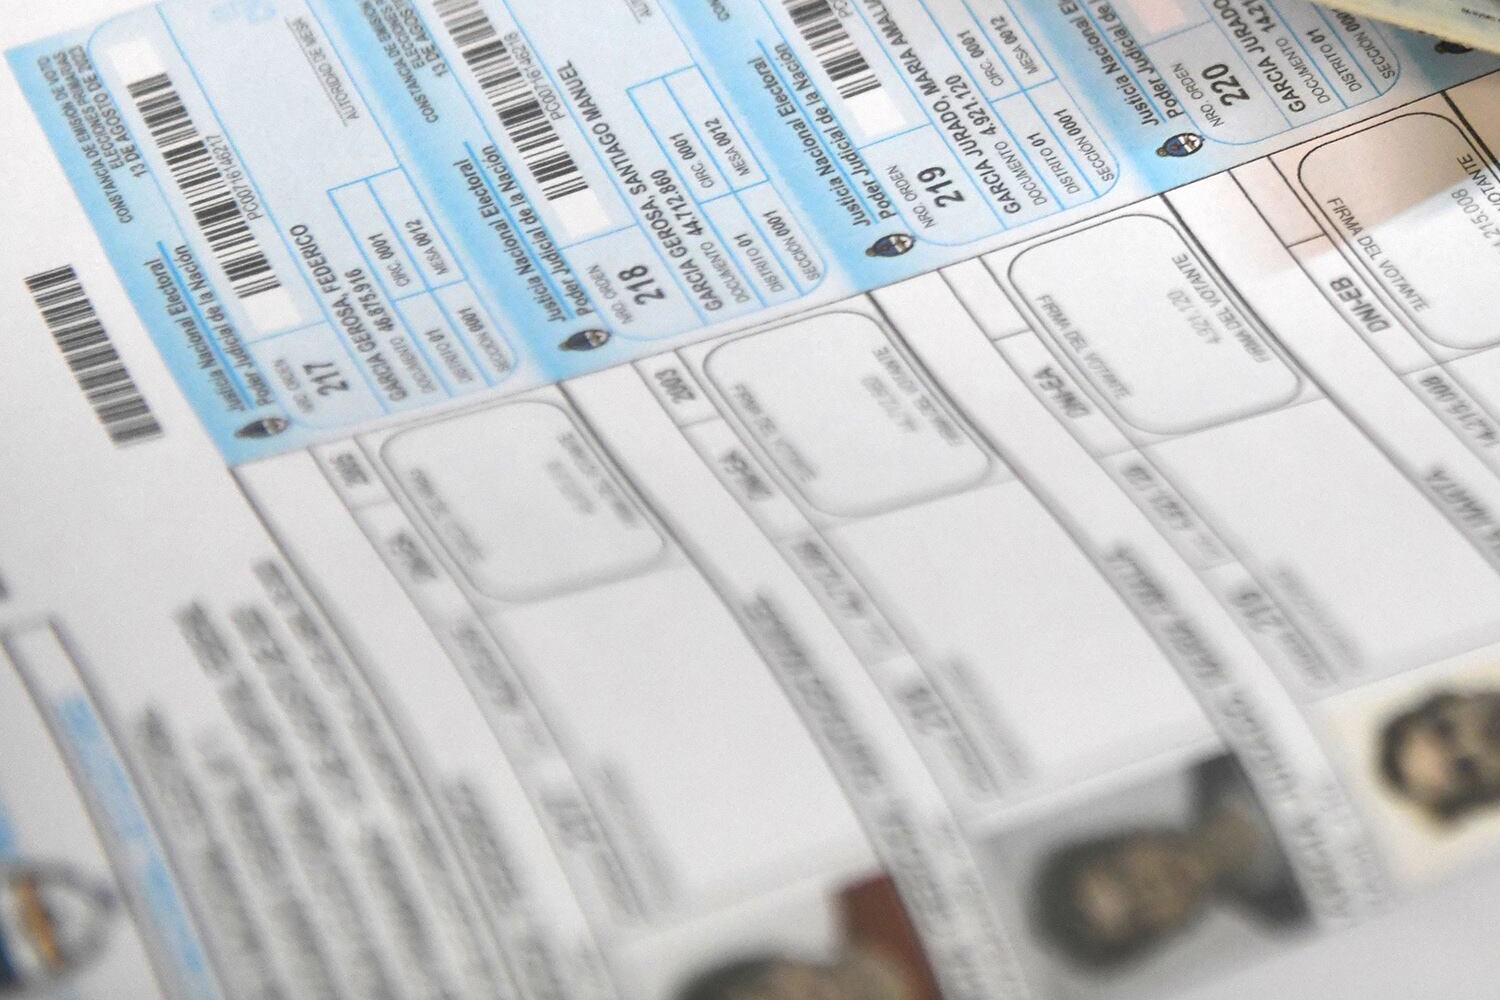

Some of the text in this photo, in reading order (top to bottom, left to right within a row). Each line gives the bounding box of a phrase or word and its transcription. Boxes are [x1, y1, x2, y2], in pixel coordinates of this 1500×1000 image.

[1090, 2, 1118, 23] de
[896, 46, 944, 95] MARIA
[955, 28, 1008, 87] CIRC. 0001
[988, 14, 1042, 74] MESA 0012
[1068, 12, 1124, 75] Nacional
[1104, 21, 1157, 77] Judicial
[1272, 35, 1335, 104] DOCUMENTO
[1304, 27, 1363, 92] DISTRITO 01
[1350, 31, 1397, 79] SECCIÓN
[81, 73, 103, 92] DE
[1109, 72, 1163, 129] Justicia
[1142, 75, 1186, 120] Poder
[1168, 61, 1226, 128] NRO. ORDEN
[1197, 59, 1255, 108] 220
[1254, 53, 1312, 113] GARCIA
[91, 91, 132, 143] AGOSTO
[702, 117, 754, 176] MESA 0012
[746, 55, 873, 230] Justicia Nacional Electoral
[767, 42, 899, 220] Poder Judicial de la Nación
[928, 93, 988, 159] JURADO,
[942, 73, 1050, 206] DOCUMENTO 4.921.120
[1051, 106, 1118, 182] SECCIÓN 0001
[118, 143, 142, 162] DE
[204, 133, 264, 221] PC00716146217
[667, 131, 716, 189] CIRC. 0001
[1025, 130, 1082, 194] DISTRITO 01
[88, 157, 135, 224] CONSTANCIA
[553, 59, 725, 312] GARCIA GEROSA, SANTIAGO MANUEL
[883, 163, 938, 229] NRO. ORDEN
[914, 163, 967, 209] 219
[971, 157, 1027, 215] GARCIA
[404, 217, 451, 275] MESA 0012
[452, 157, 568, 325] Justicia Nacional Electoral
[475, 144, 595, 317] Poder Judicial de la Nación
[648, 167, 753, 303] DOCUMENTO 44.712.860
[761, 208, 792, 237] 0001
[1325, 195, 1366, 236] FIRMA
[1356, 234, 1383, 258] DEL
[366, 232, 413, 287] CIRC. 0001
[614, 262, 668, 306] 218
[732, 231, 786, 293] DISTRITO 01
[1170, 251, 1227, 309] VOTANTE
[287, 222, 410, 402] GARCIA GEROSA, FEDERICO
[343, 266, 398, 334] 46.875.916
[456, 305, 485, 333] 0001
[584, 263, 636, 325] NRO. ORDEN
[1034, 294, 1073, 331] FIRMA
[141, 257, 248, 415] Justicia Nacional Electoral
[168, 244, 278, 406] Poder Judicial de la Nación
[300, 356, 351, 398] 217
